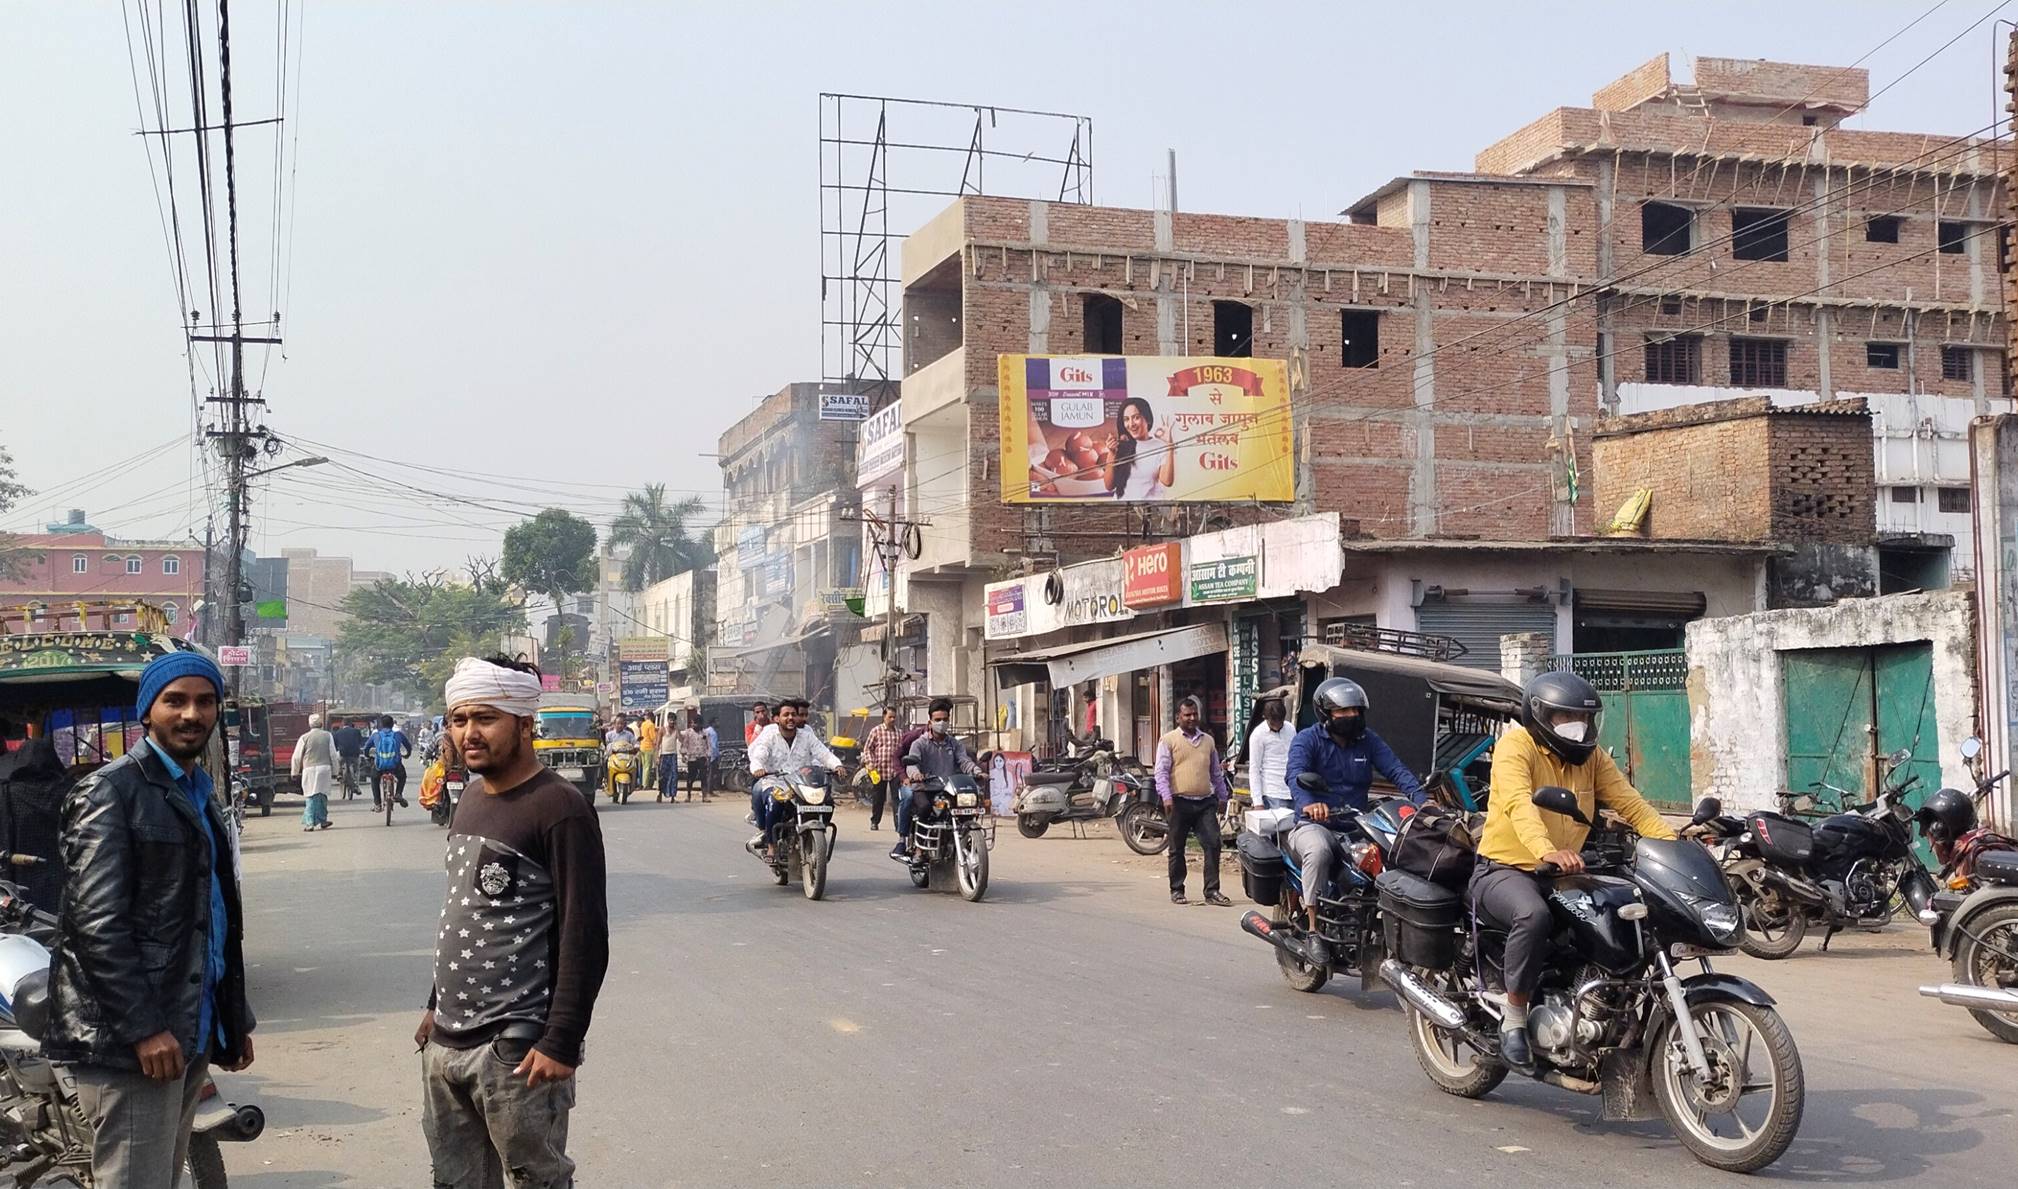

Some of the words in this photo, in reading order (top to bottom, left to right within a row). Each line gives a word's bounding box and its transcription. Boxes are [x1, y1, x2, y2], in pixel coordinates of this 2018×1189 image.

[1060, 367, 1093, 383] Gits
[1193, 366, 1232, 384] 1963
[830, 395, 868, 406] SAFAL
[1209, 388, 1222, 405] से
[1060, 402, 1093, 411] GULAB
[1061, 411, 1094, 421] JAMUN
[1175, 413, 1214, 431] गुलाब
[1219, 413, 1258, 431] जामुन
[1196, 432, 1239, 445] मतलब
[1199, 451, 1238, 470] Gits
[1217, 562, 1226, 579] टी
[1224, 578, 1249, 588] COMPANY
[27, 655, 67, 667] 2017
